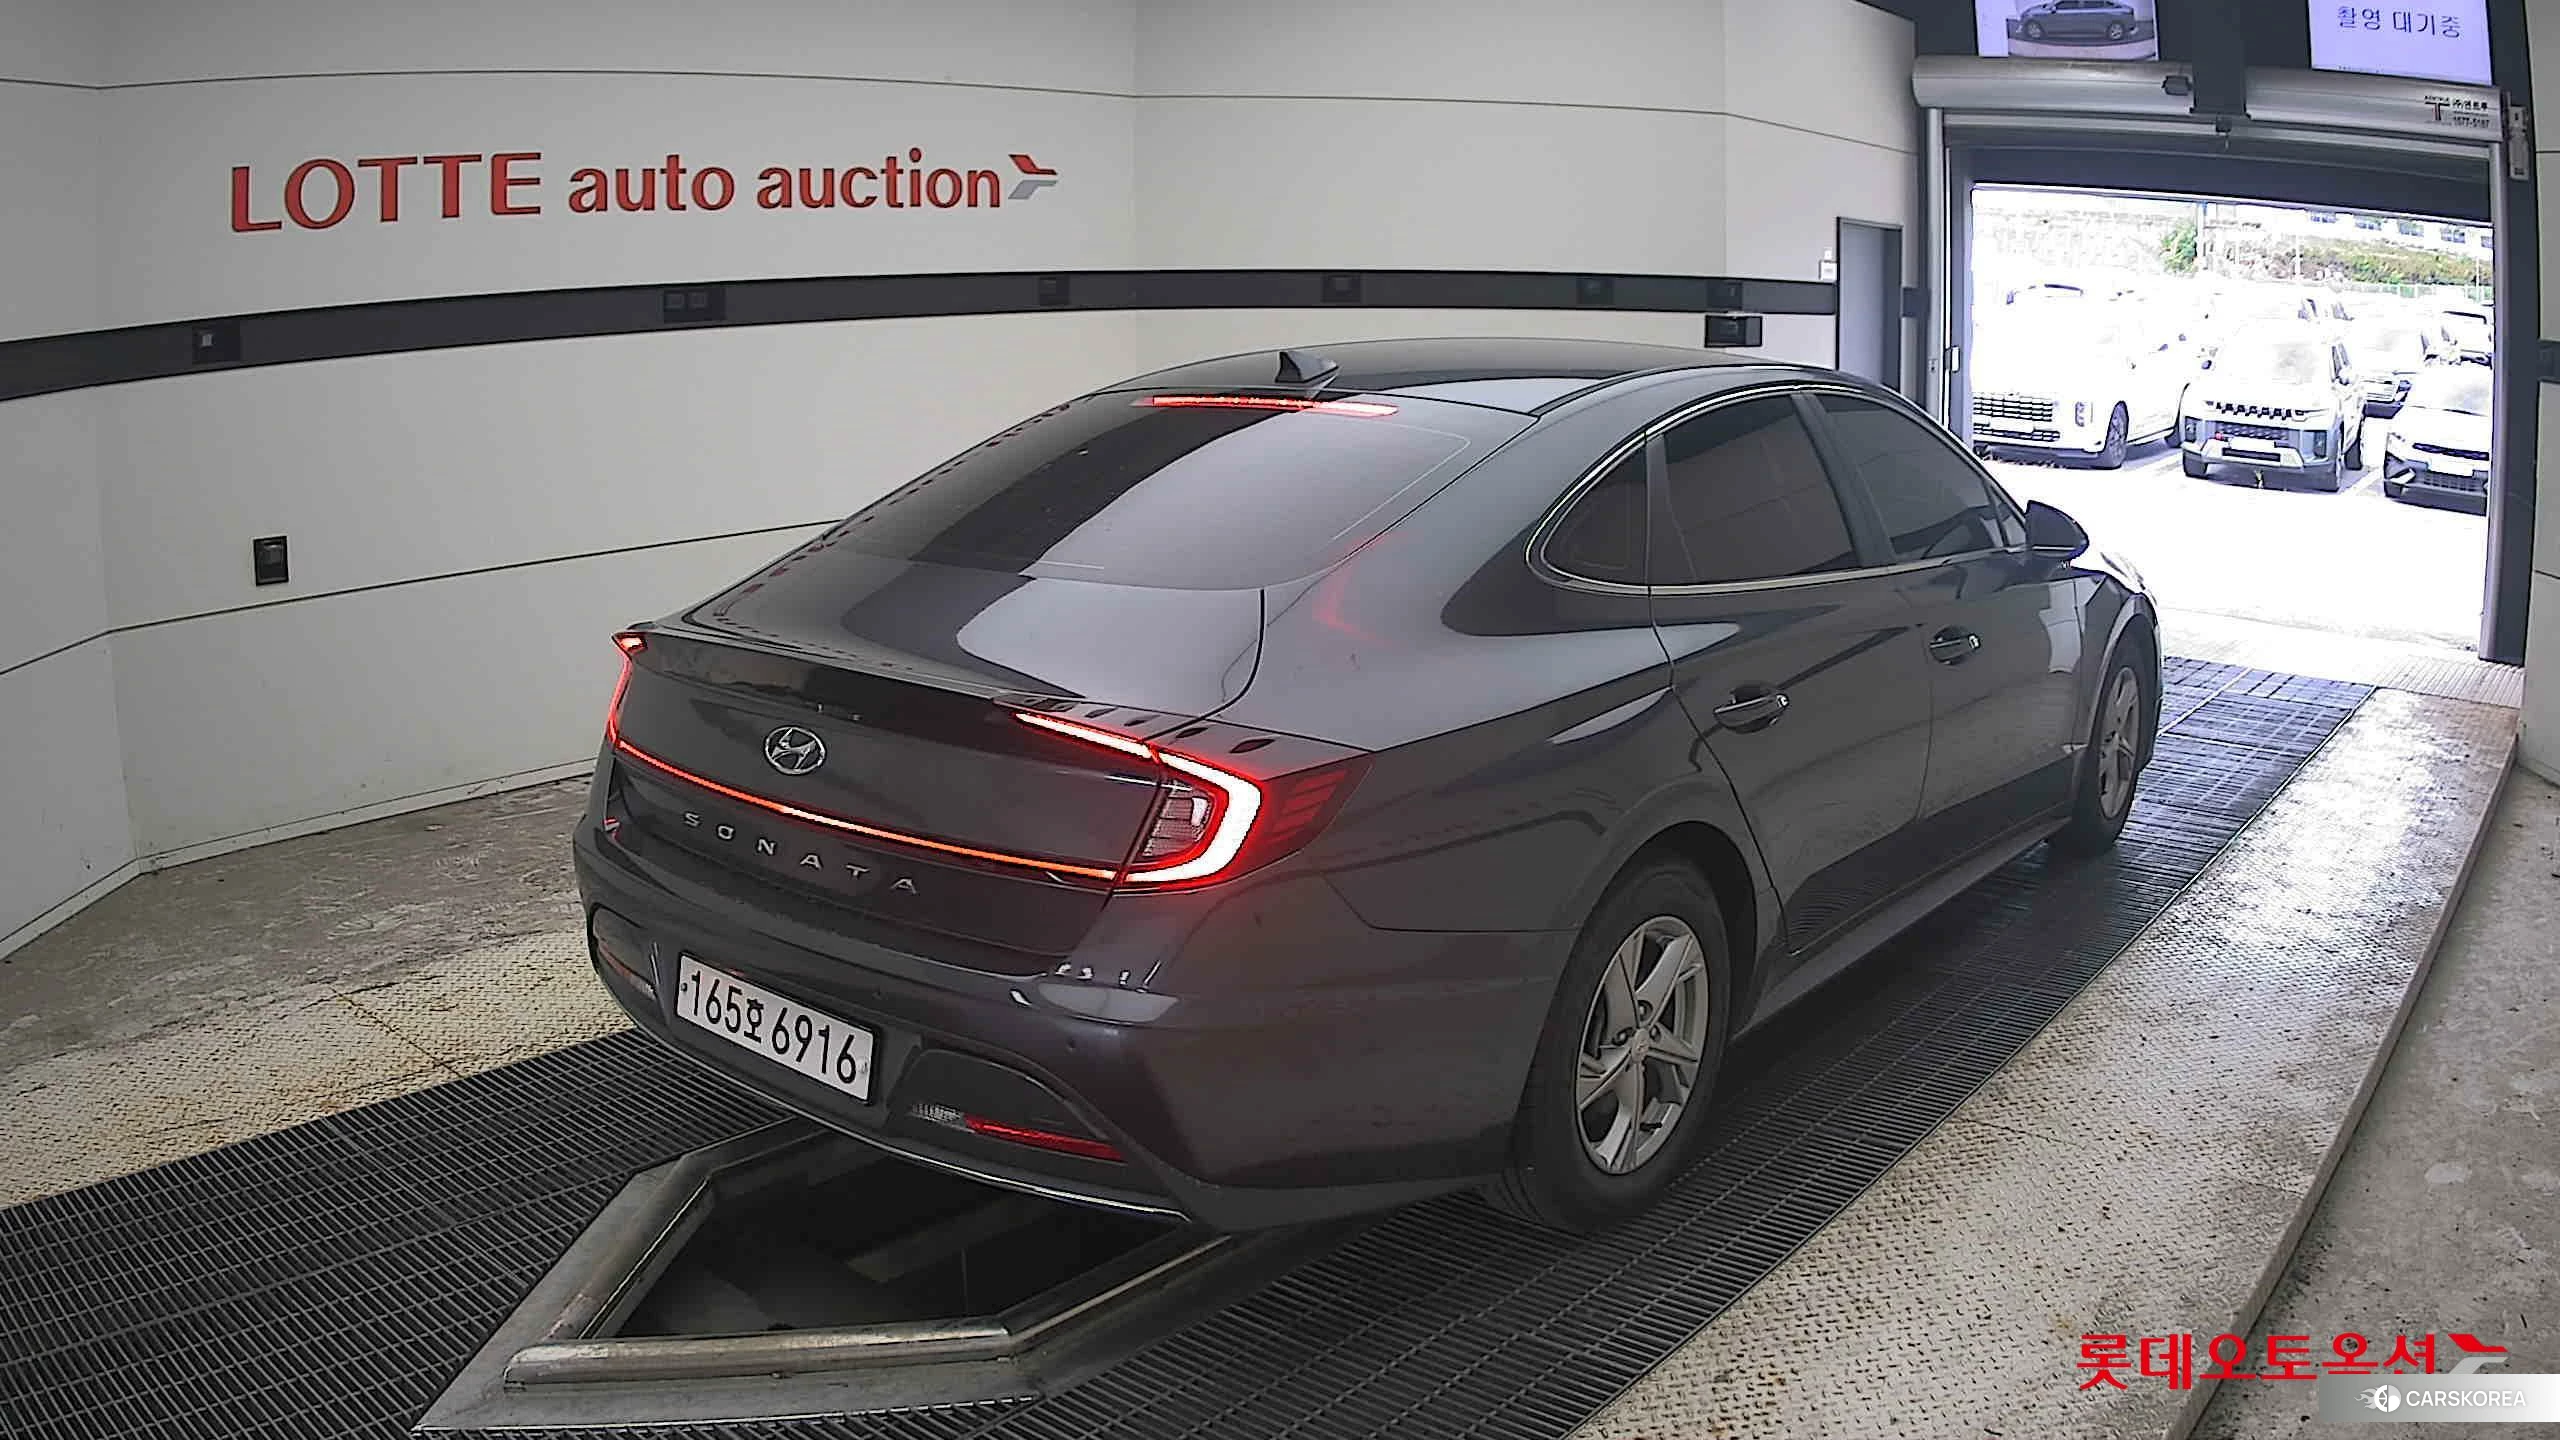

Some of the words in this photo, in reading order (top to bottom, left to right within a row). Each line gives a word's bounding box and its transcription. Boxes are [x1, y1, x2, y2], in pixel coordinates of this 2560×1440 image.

[2337, 6, 2381, 31] 촬영
[2392, 11, 2461, 38] 대기중
[231, 153, 542, 232] LOTTE
[568, 153, 735, 213] auto
[756, 147, 1001, 209] auction
[684, 812, 918, 894] SONATA
